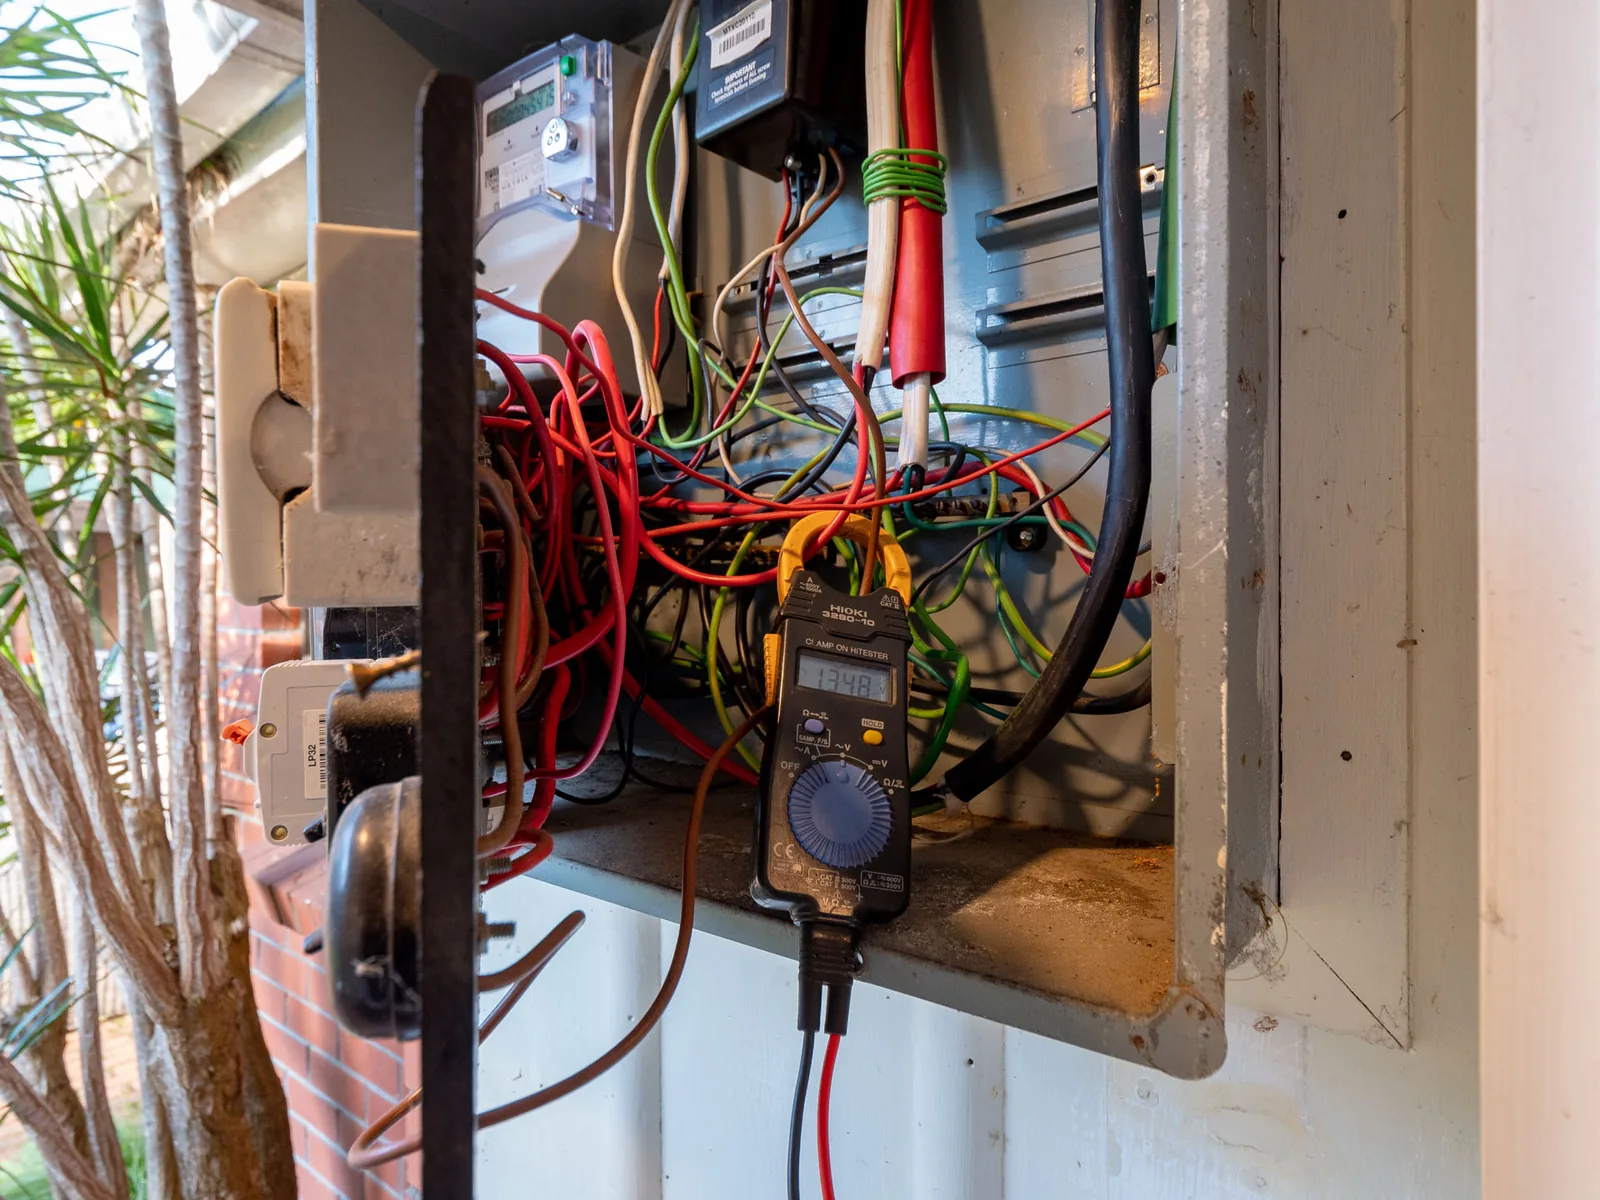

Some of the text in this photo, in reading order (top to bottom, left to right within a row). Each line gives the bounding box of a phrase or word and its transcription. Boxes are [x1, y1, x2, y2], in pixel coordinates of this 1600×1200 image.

[724, 61, 757, 84] IMPORTANT
[830, 604, 868, 618] HIOKI
[822, 610, 875, 627] 3280-10
[836, 643, 848, 653] ON
[863, 720, 883, 729] HOLD
[307, 744, 317, 768] LP32
[780, 760, 800, 771] OFF
